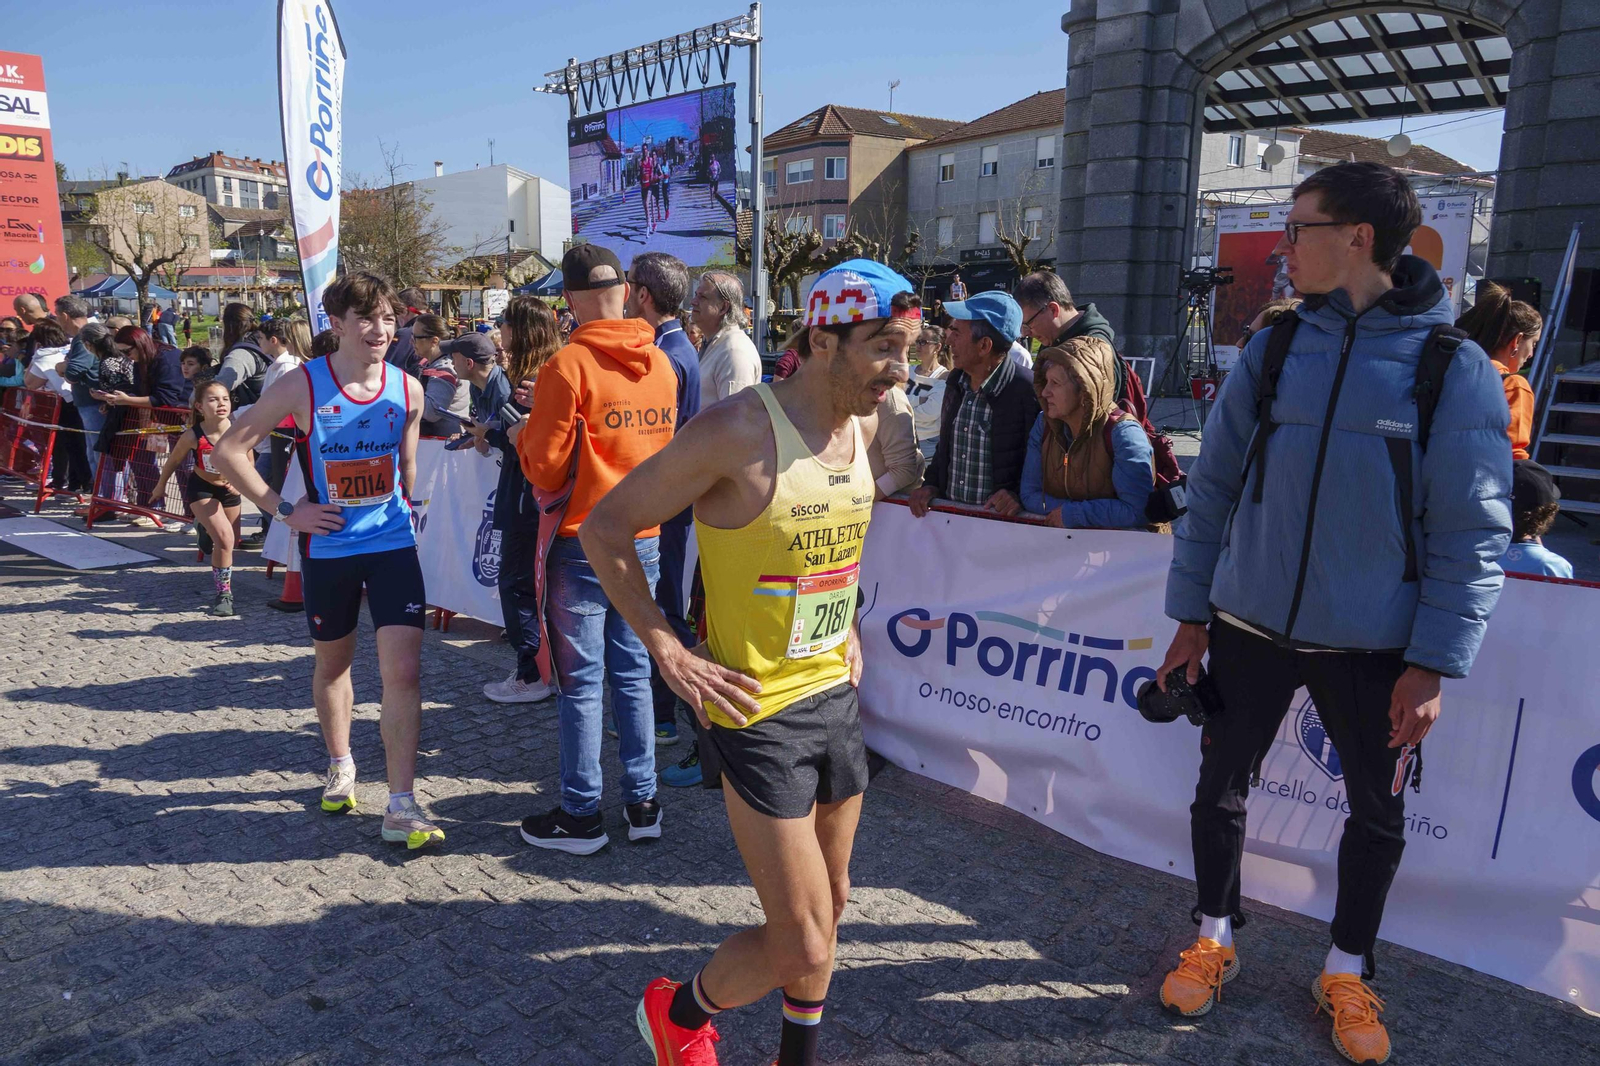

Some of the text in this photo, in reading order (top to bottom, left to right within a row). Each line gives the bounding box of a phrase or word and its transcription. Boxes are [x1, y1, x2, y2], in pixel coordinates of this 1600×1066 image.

[4, 231, 38, 239] Maceira
[1203, 383, 1216, 401] 2
[1375, 424, 1412, 433] ADVENTURE
[1377, 419, 1404, 428] adidas
[320, 443, 349, 454] Celta
[340, 473, 386, 497] 2014
[787, 520, 869, 551] ATHLETIC
[804, 545, 857, 568] San Lázaro
[810, 596, 851, 640] 2181
[887, 608, 1157, 711] O Porriño
